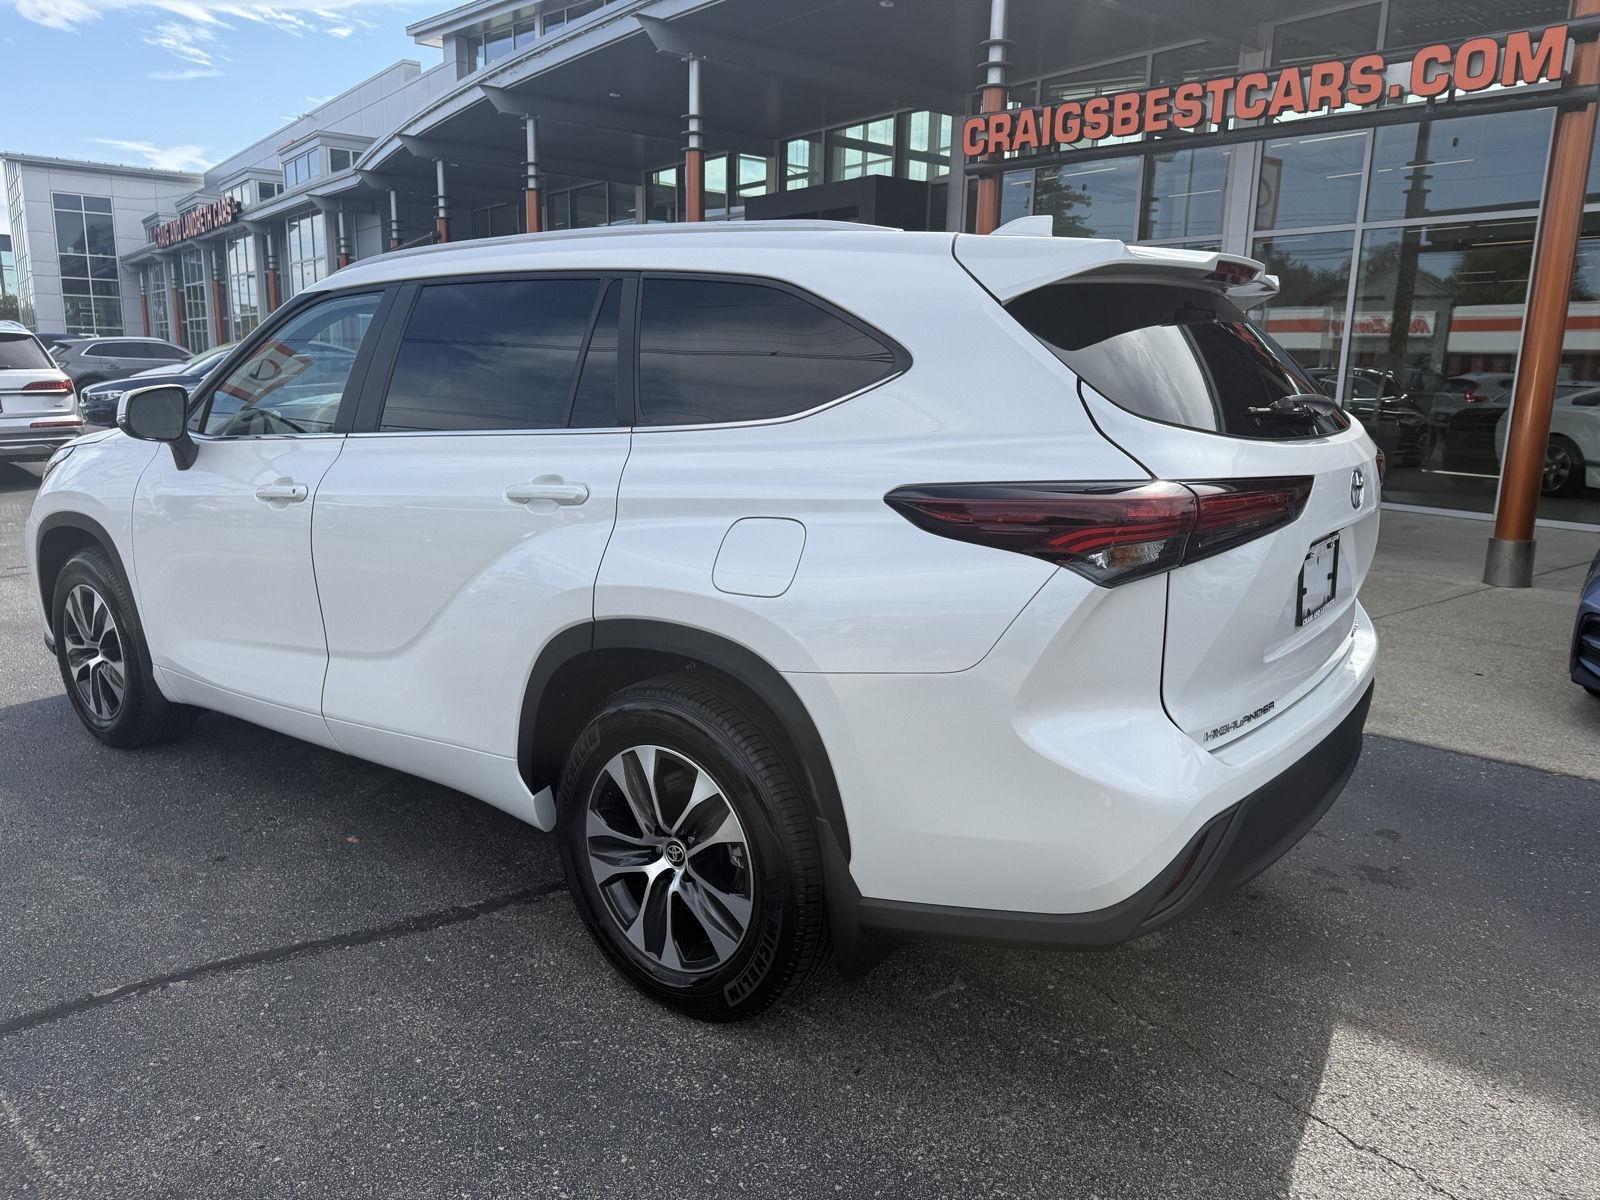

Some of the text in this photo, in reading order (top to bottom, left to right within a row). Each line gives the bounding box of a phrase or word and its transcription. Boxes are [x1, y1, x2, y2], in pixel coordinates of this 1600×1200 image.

[962, 25, 1569, 157] CRAIGSBESTCARS.COM
[212, 196, 232, 228] CARS
[1203, 701, 1275, 742] HIGHLANDER
[726, 917, 780, 1003] MICHELIN
